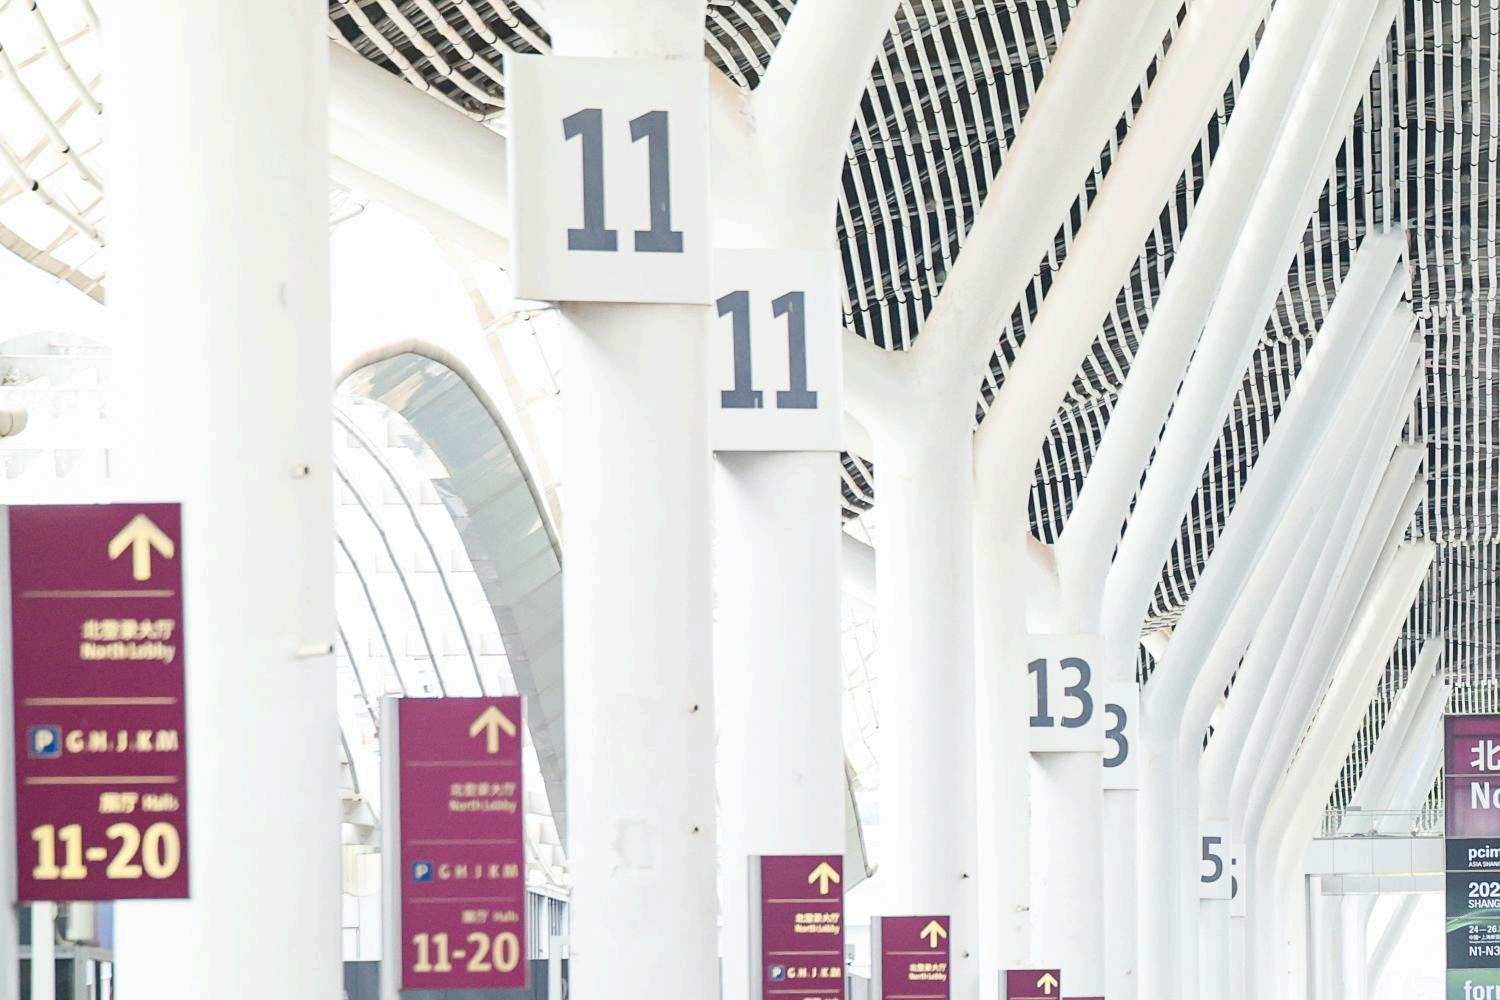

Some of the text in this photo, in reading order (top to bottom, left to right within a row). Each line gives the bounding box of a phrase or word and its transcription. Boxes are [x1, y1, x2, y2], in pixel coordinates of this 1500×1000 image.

[562, 108, 684, 253] 11
[716, 290, 818, 409] 11
[1028, 657, 1094, 728] 13
[1103, 703, 1129, 768] 3
[31, 822, 181, 880] 11-20
[1200, 836, 1223, 883] 5
[412, 932, 520, 973] 11-20
[1469, 946, 1500, 956] N1-N3
